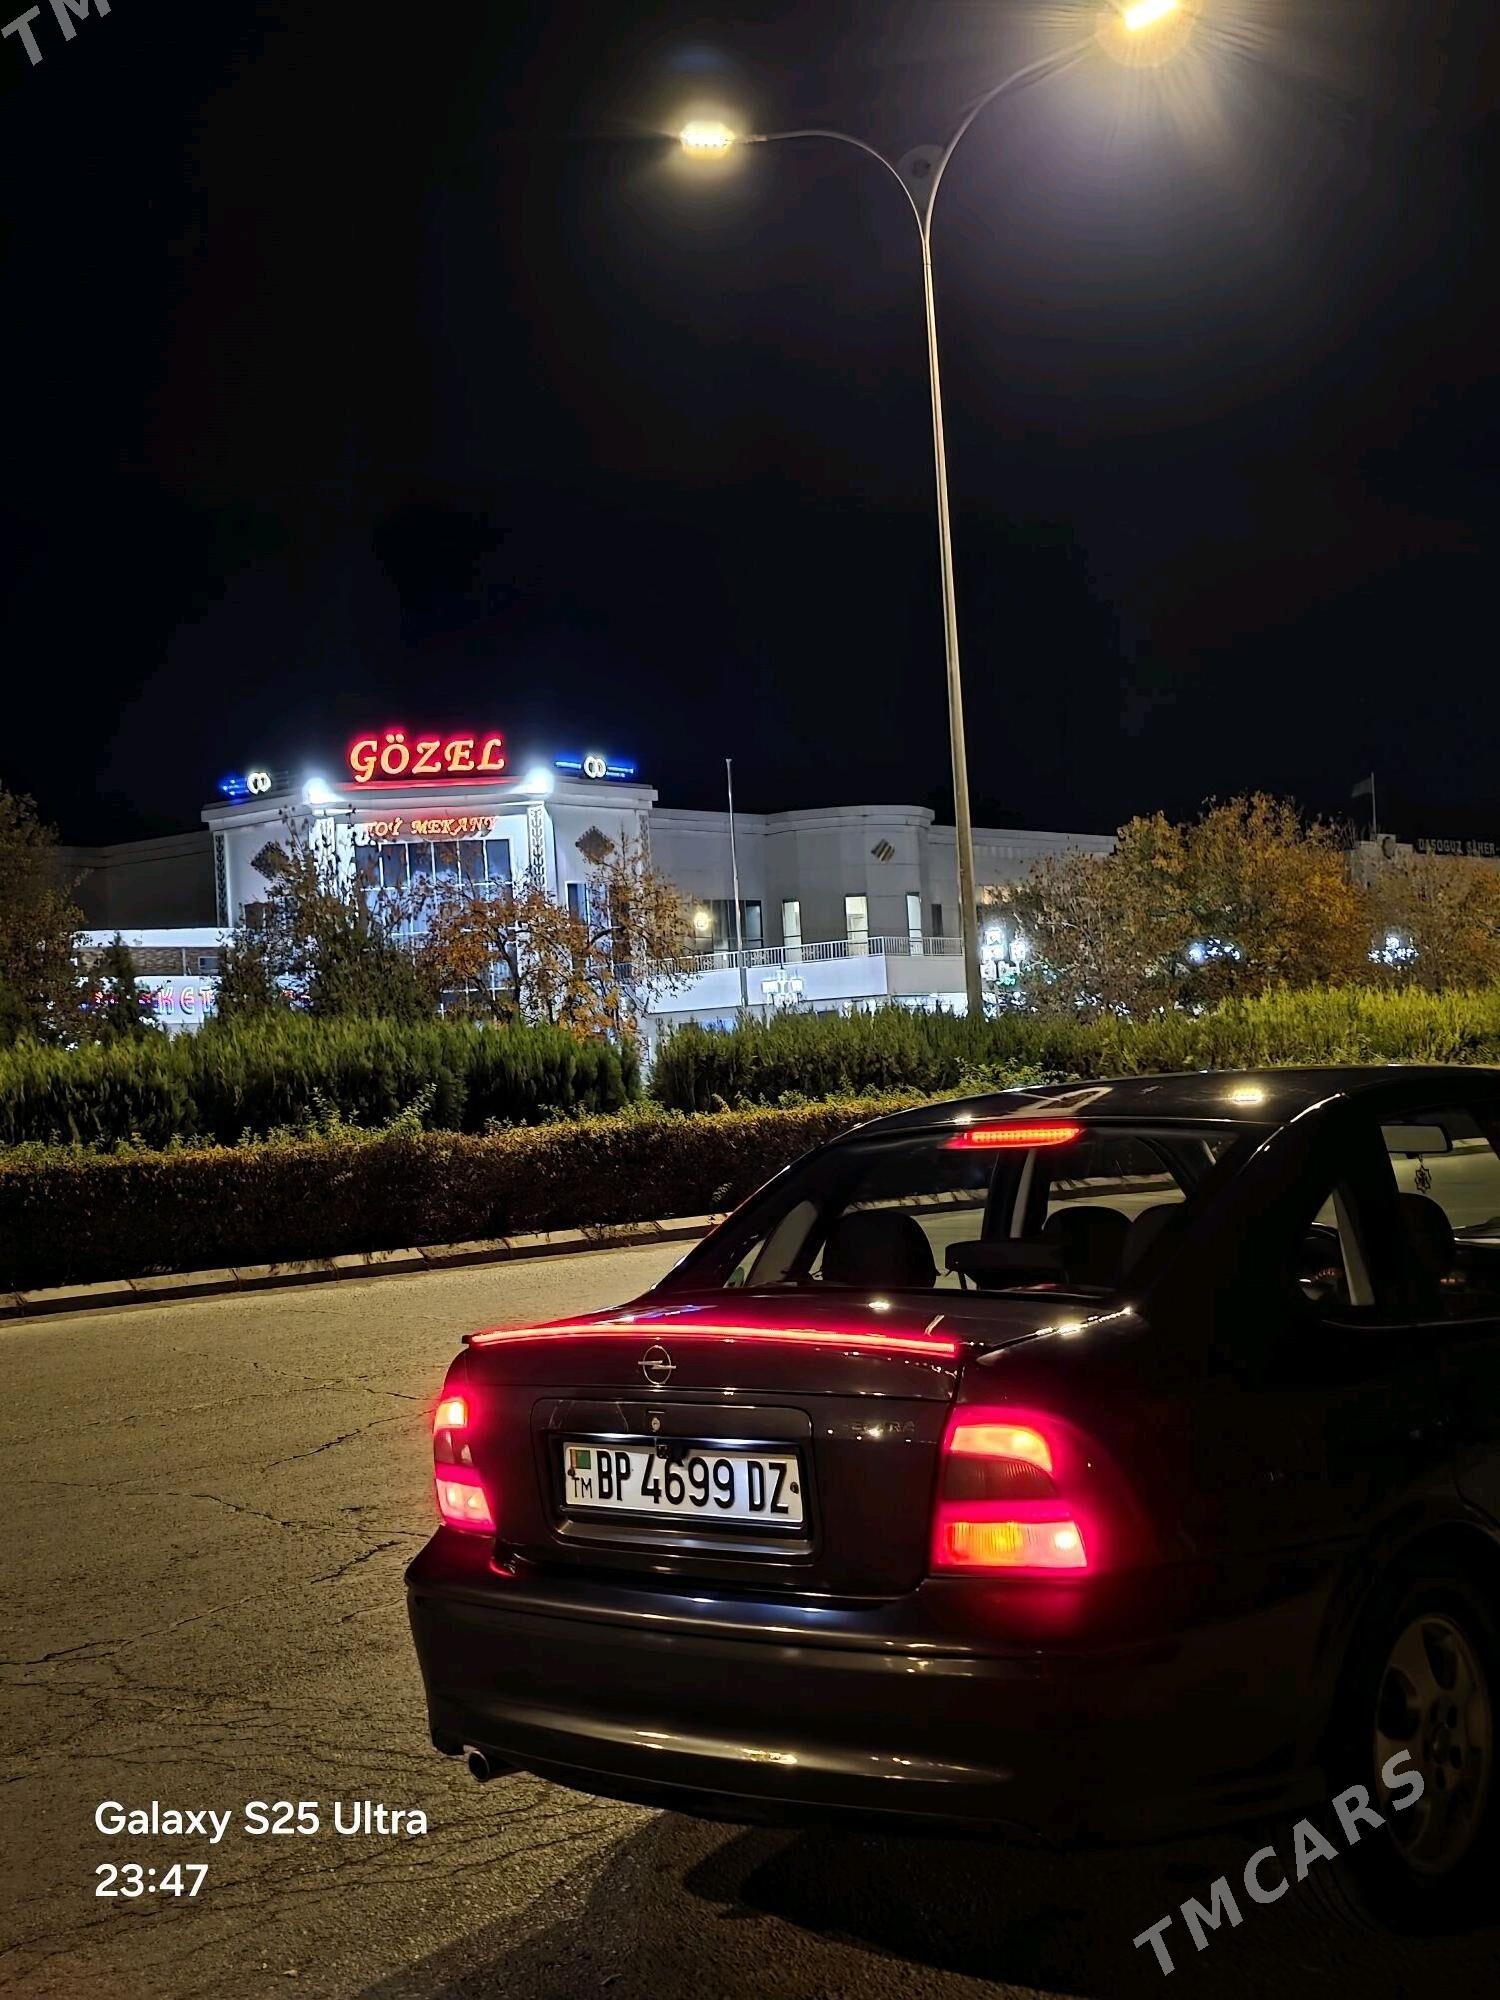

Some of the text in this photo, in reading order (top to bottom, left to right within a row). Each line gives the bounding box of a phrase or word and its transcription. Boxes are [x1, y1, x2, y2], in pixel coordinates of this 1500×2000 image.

[350, 733, 505, 783] GÖZEL
[573, 1476, 593, 1499] TM
[596, 1450, 789, 1515] BP 4699 DZ
